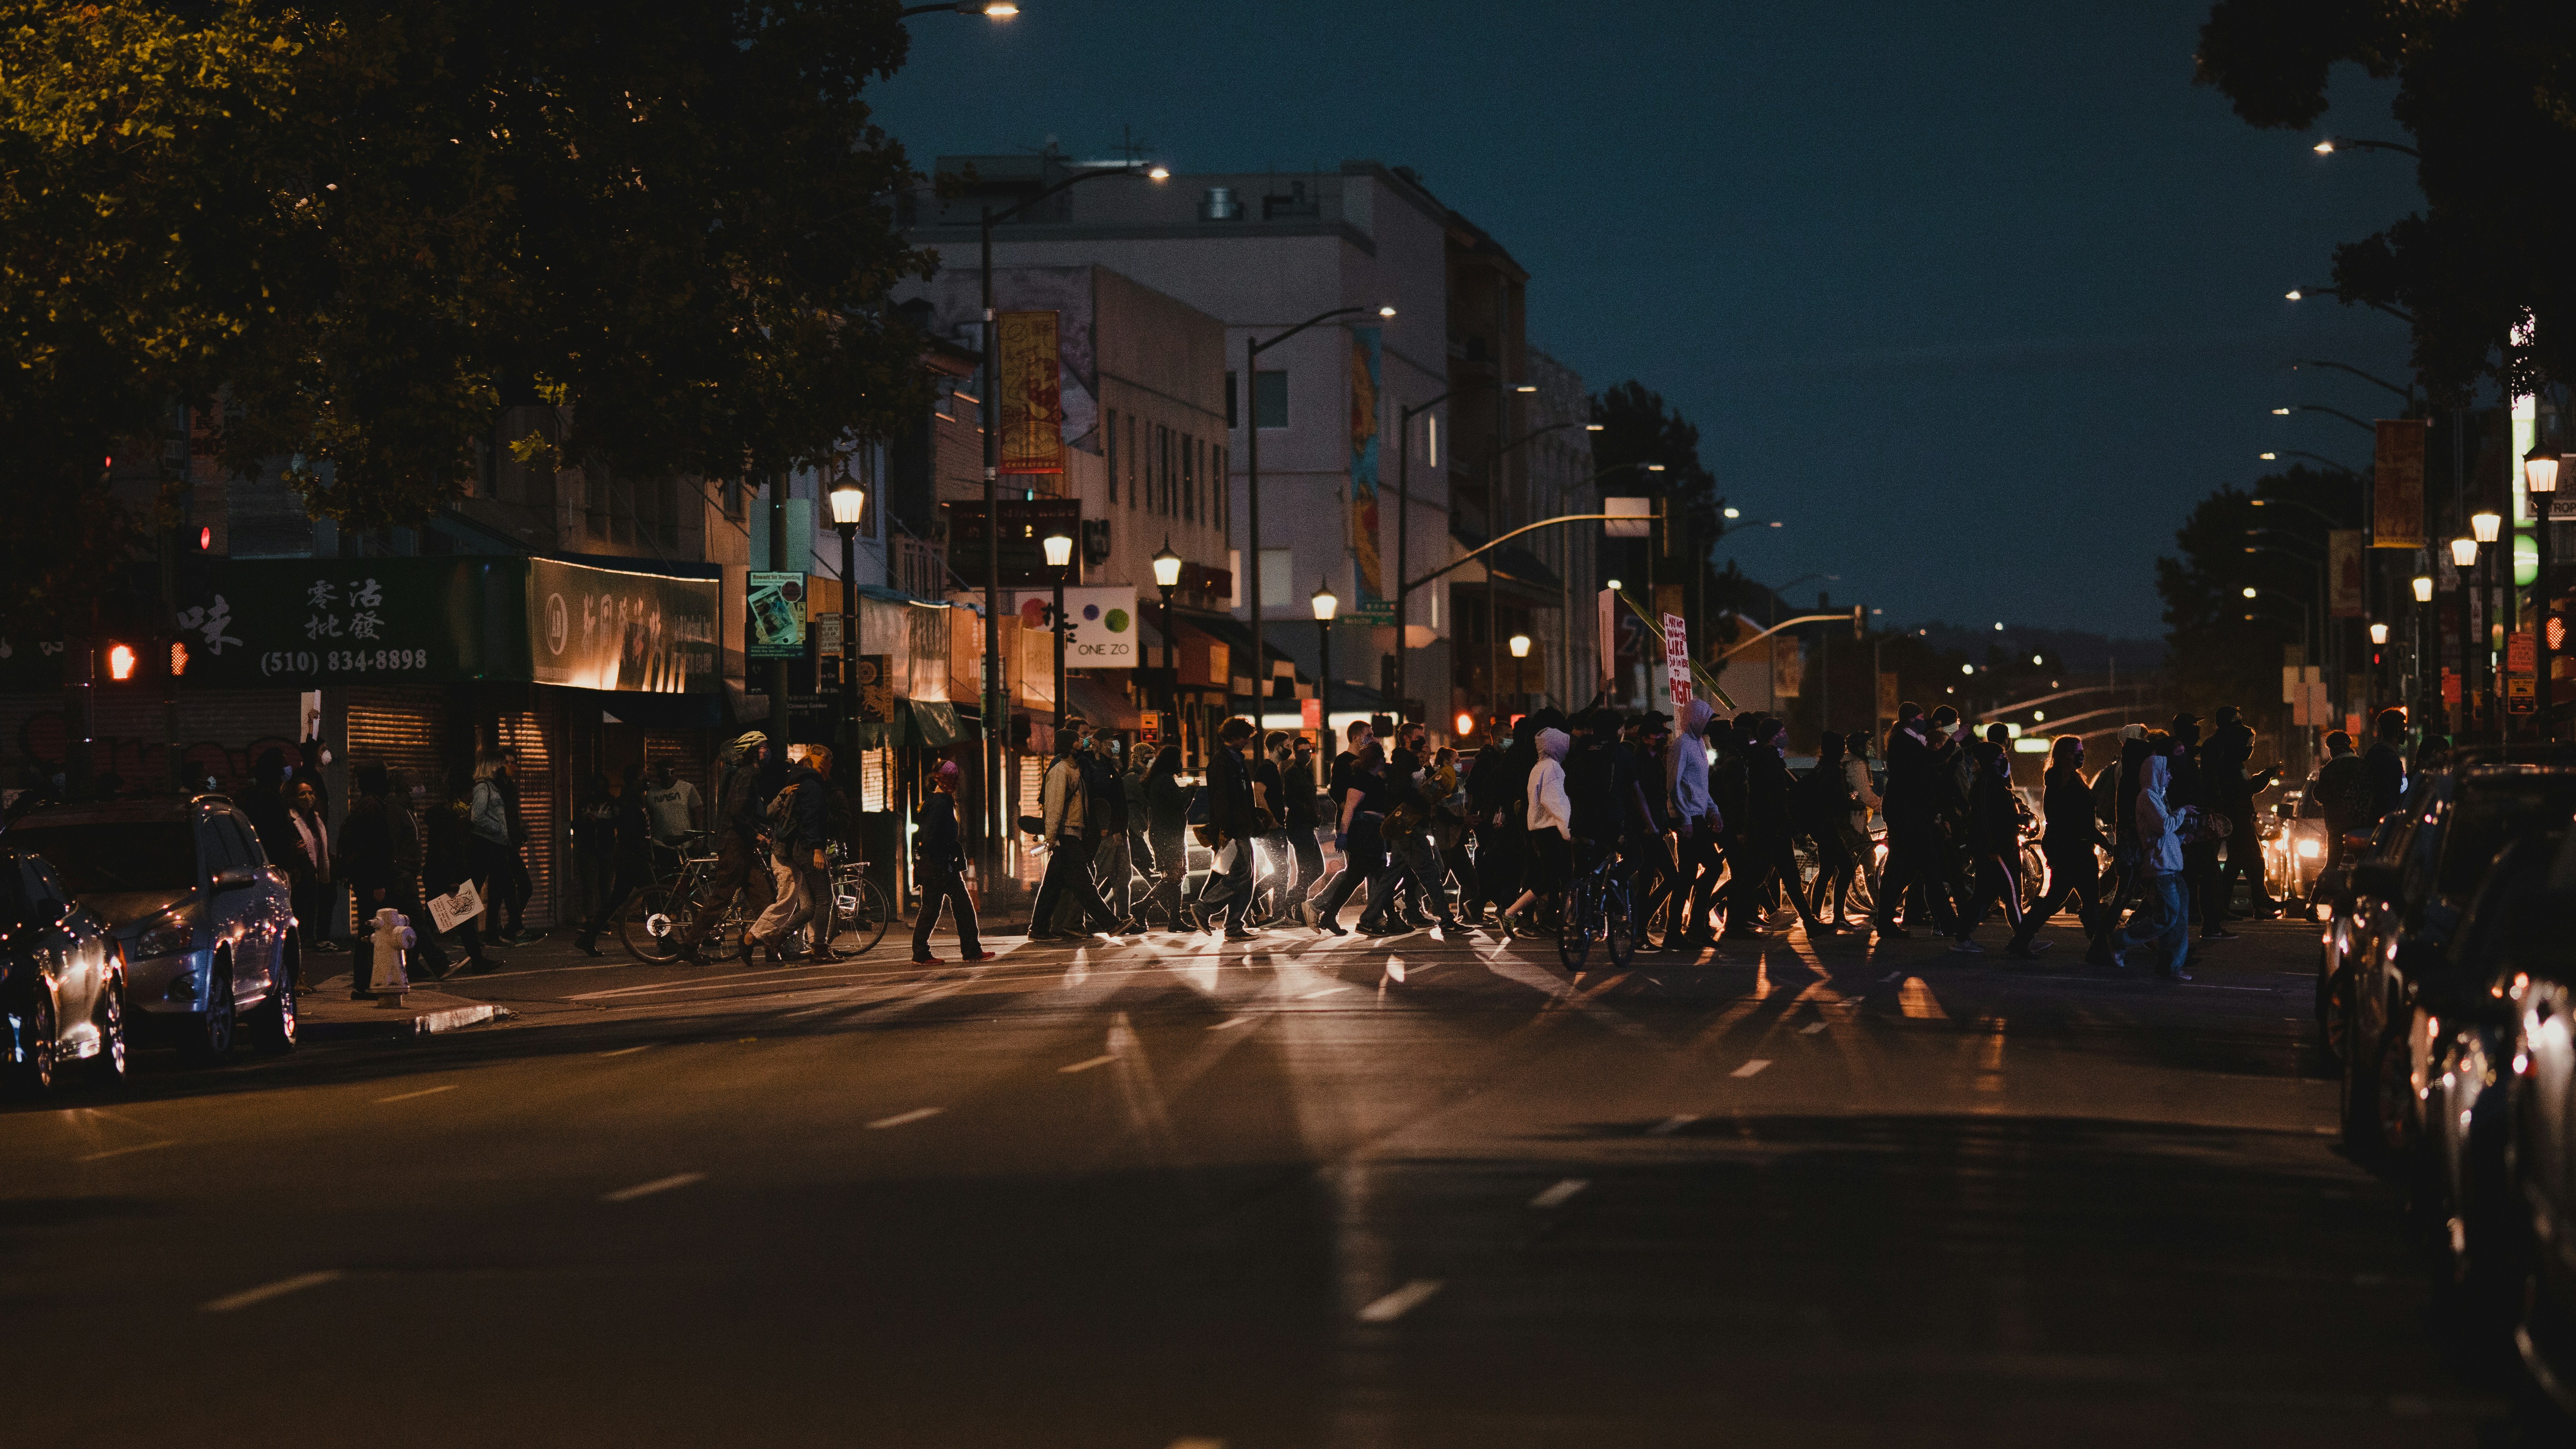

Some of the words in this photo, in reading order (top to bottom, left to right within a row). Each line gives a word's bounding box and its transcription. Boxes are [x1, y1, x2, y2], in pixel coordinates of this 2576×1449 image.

[306, 578, 383, 610] 零沽
[176, 594, 243, 656] 味
[303, 612, 385, 640] 批發
[1078, 644, 1106, 655] ONE
[1110, 644, 1129, 655] ZO
[1668, 639, 1684, 656] LIKE
[261, 650, 319, 676] (510)
[328, 649, 427, 672] 834-8898
[884, 657, 893, 721] CHINATOWN
[1670, 678, 1691, 704] FIGHT
[655, 792, 681, 804] NASA
